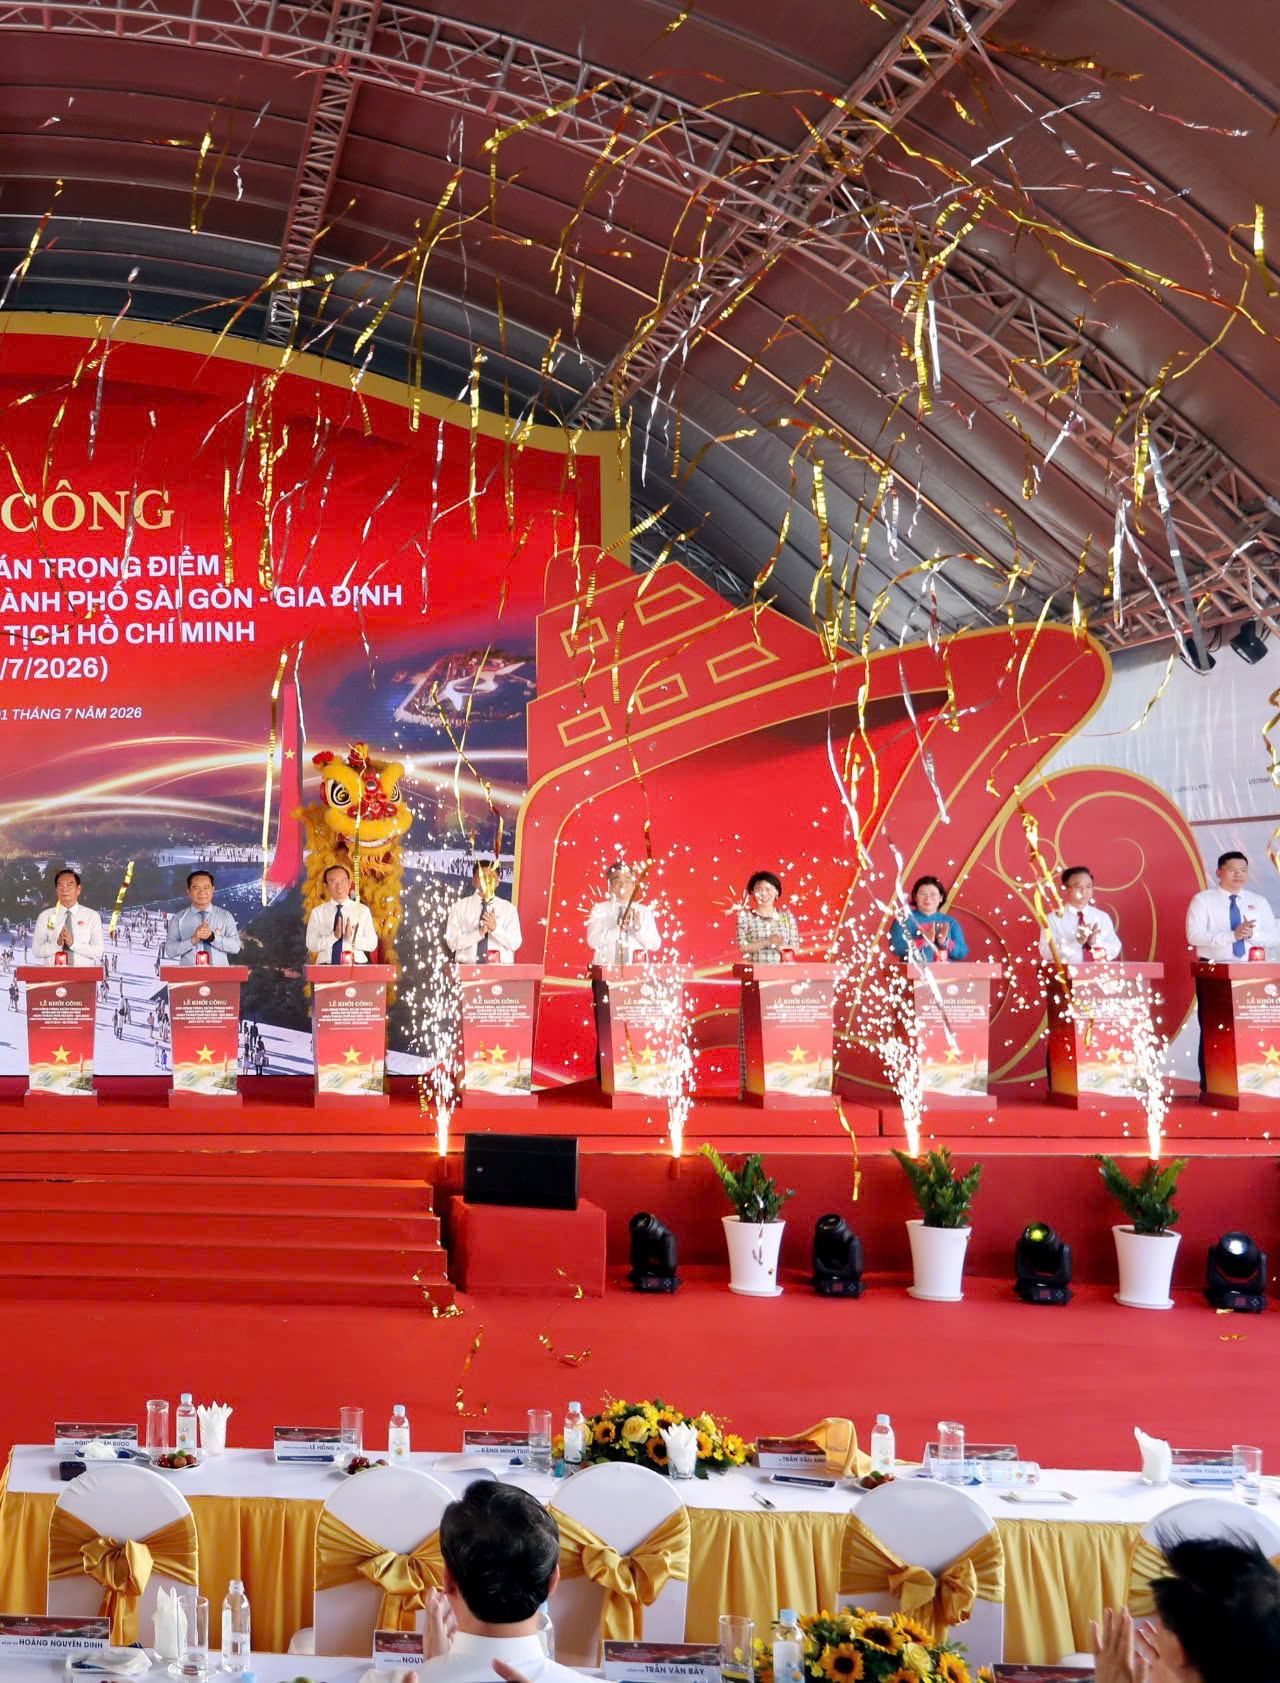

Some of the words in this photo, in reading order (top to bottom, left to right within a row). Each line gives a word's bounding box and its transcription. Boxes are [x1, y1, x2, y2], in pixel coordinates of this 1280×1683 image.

[1, 479, 175, 533] CÔNG
[39, 557, 141, 583] TRỌNG
[147, 545, 220, 577] ĐIỂM
[68, 580, 129, 612] PHỐ
[135, 582, 181, 610] SÀI
[188, 583, 253, 609] GÒN
[276, 585, 326, 608] GIA
[330, 583, 403, 613] ĐỊNH
[3, 624, 69, 651] TỊCH
[77, 613, 119, 646] HỒ
[125, 617, 175, 645] CHÍ
[181, 620, 255, 643] MINH
[12, 706, 62, 720] THÁNG
[64, 708, 72, 719] 7
[74, 705, 107, 719] NĂM
[109, 707, 142, 719] 2026
